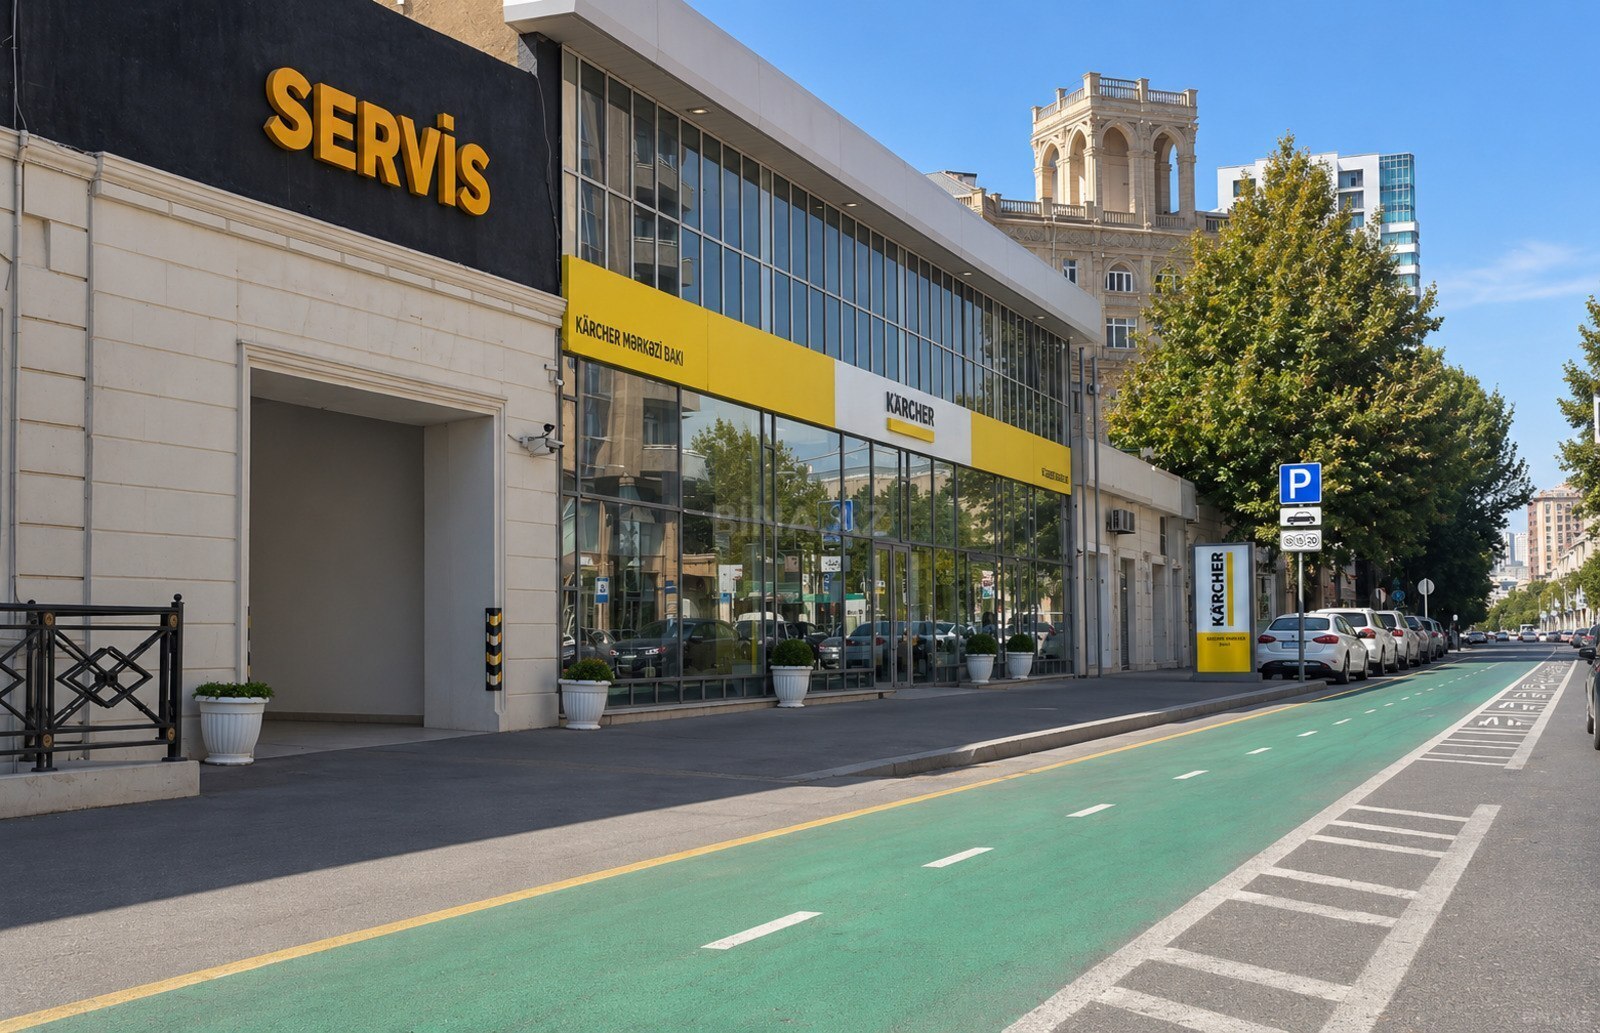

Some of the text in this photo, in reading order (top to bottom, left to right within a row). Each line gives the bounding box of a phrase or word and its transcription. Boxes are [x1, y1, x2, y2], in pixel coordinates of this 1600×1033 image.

[263, 66, 491, 216] SERVİS
[575, 314, 621, 346] KÄRCHER
[664, 345, 684, 367] BAKI
[886, 391, 934, 427] KÄRCHER
[1289, 468, 1311, 500] P
[1209, 551, 1225, 627] KÄRCHER
